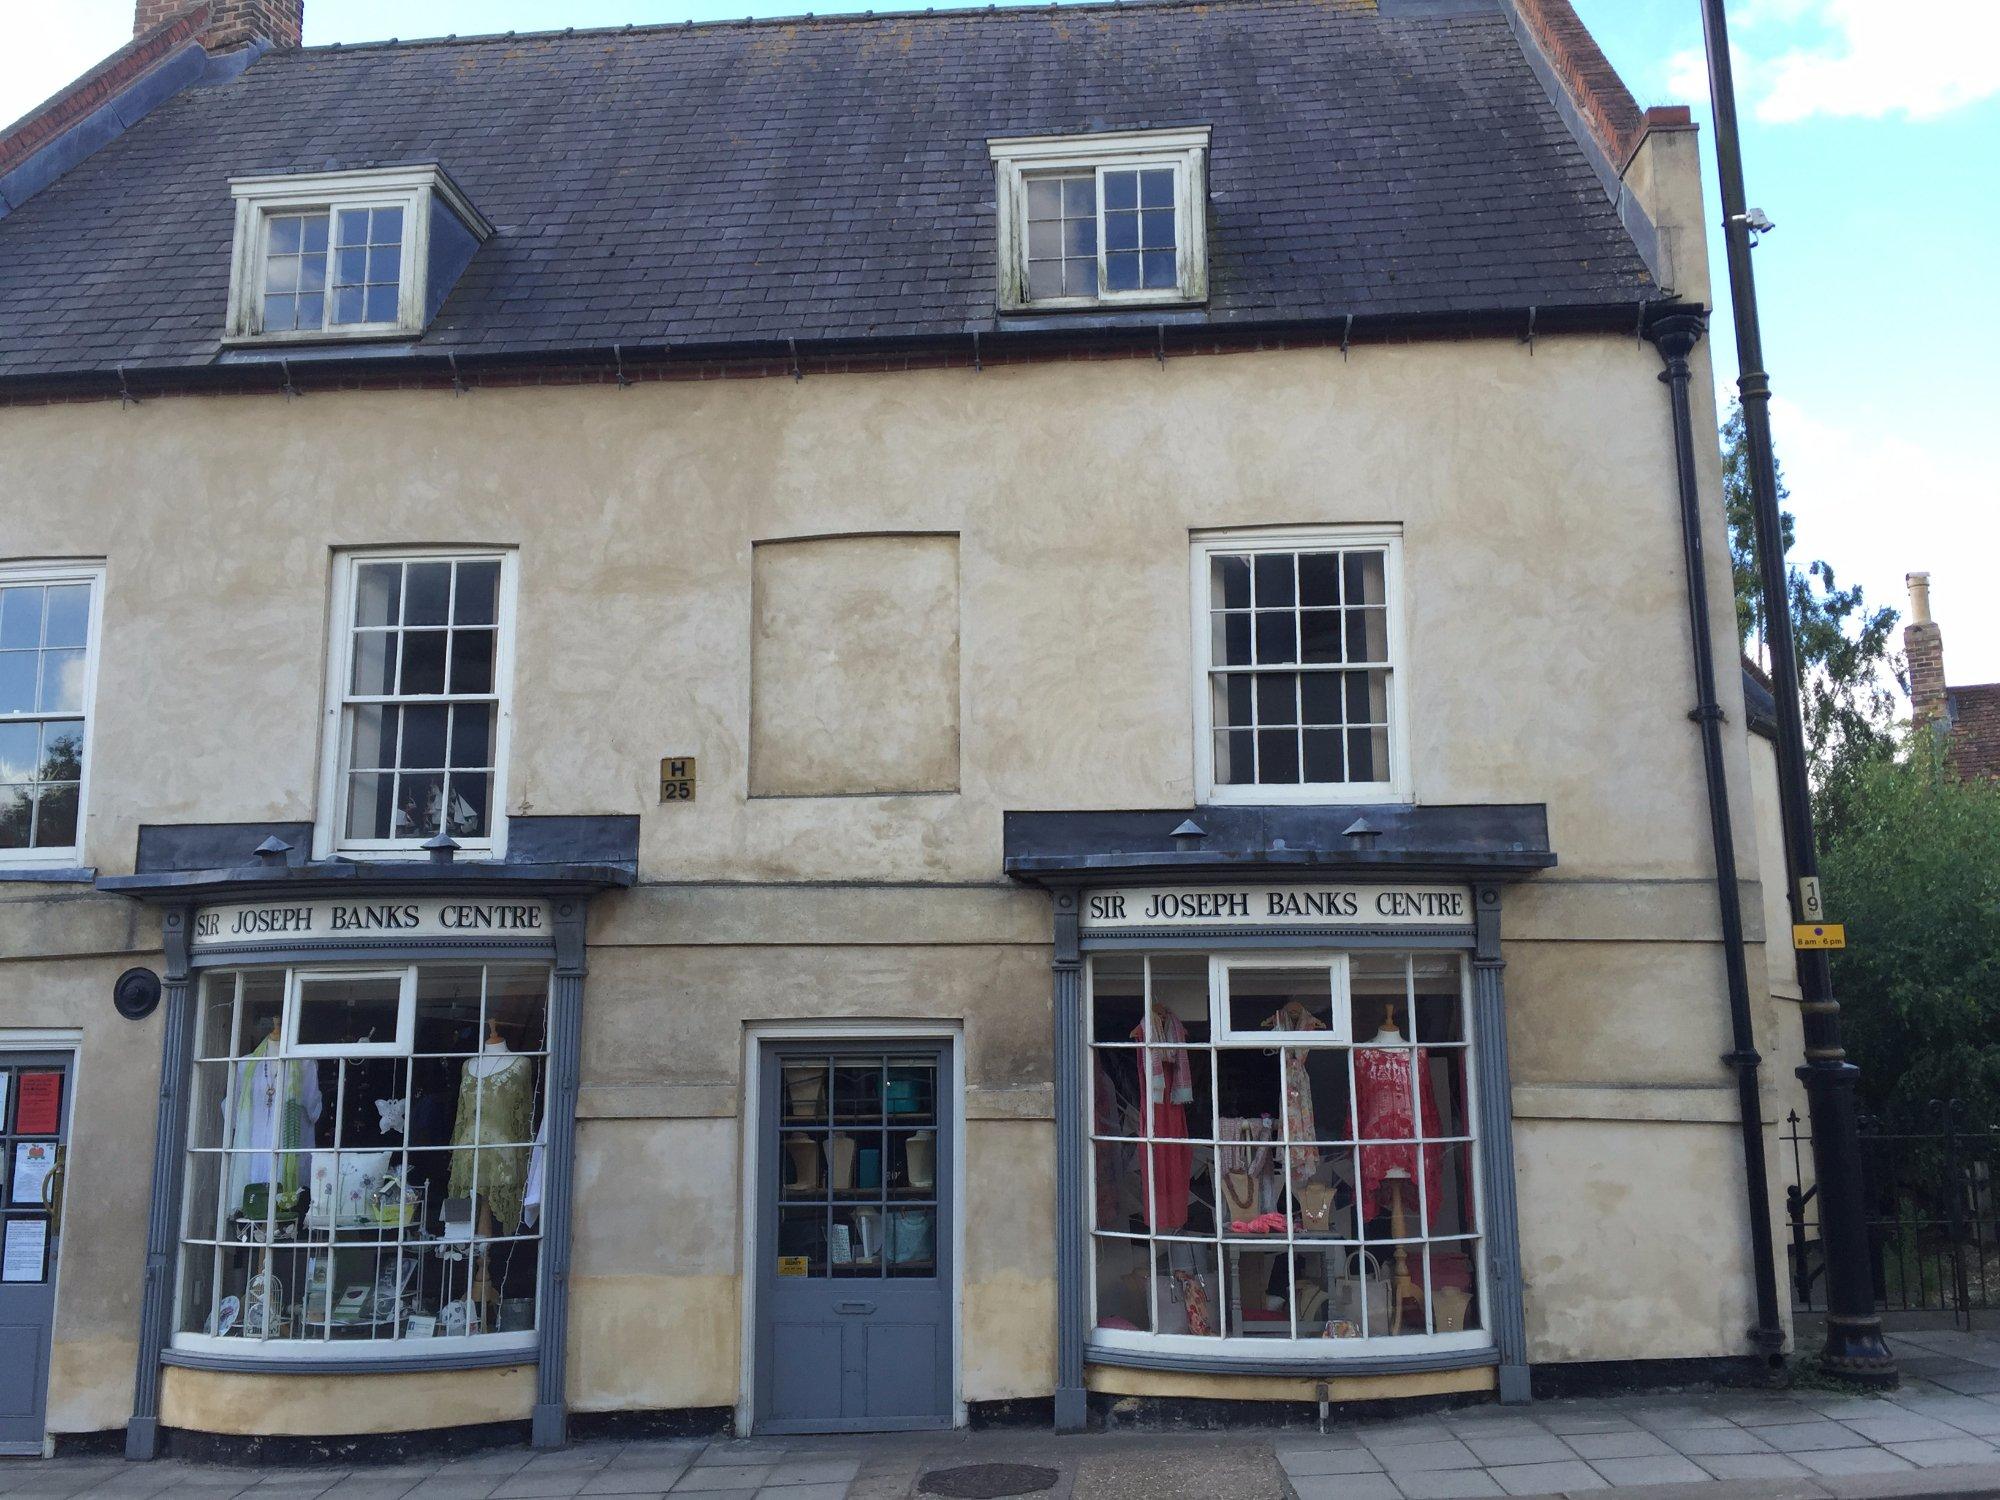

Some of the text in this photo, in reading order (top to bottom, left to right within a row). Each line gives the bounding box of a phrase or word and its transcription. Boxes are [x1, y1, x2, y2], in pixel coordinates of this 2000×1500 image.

[671, 761, 685, 777] H
[665, 782, 690, 799] 25
[1089, 891, 1463, 920] SIR JOSEPH BANKS CENTRE
[197, 904, 542, 937] SIR JOSEPH BANKS CENTRE
